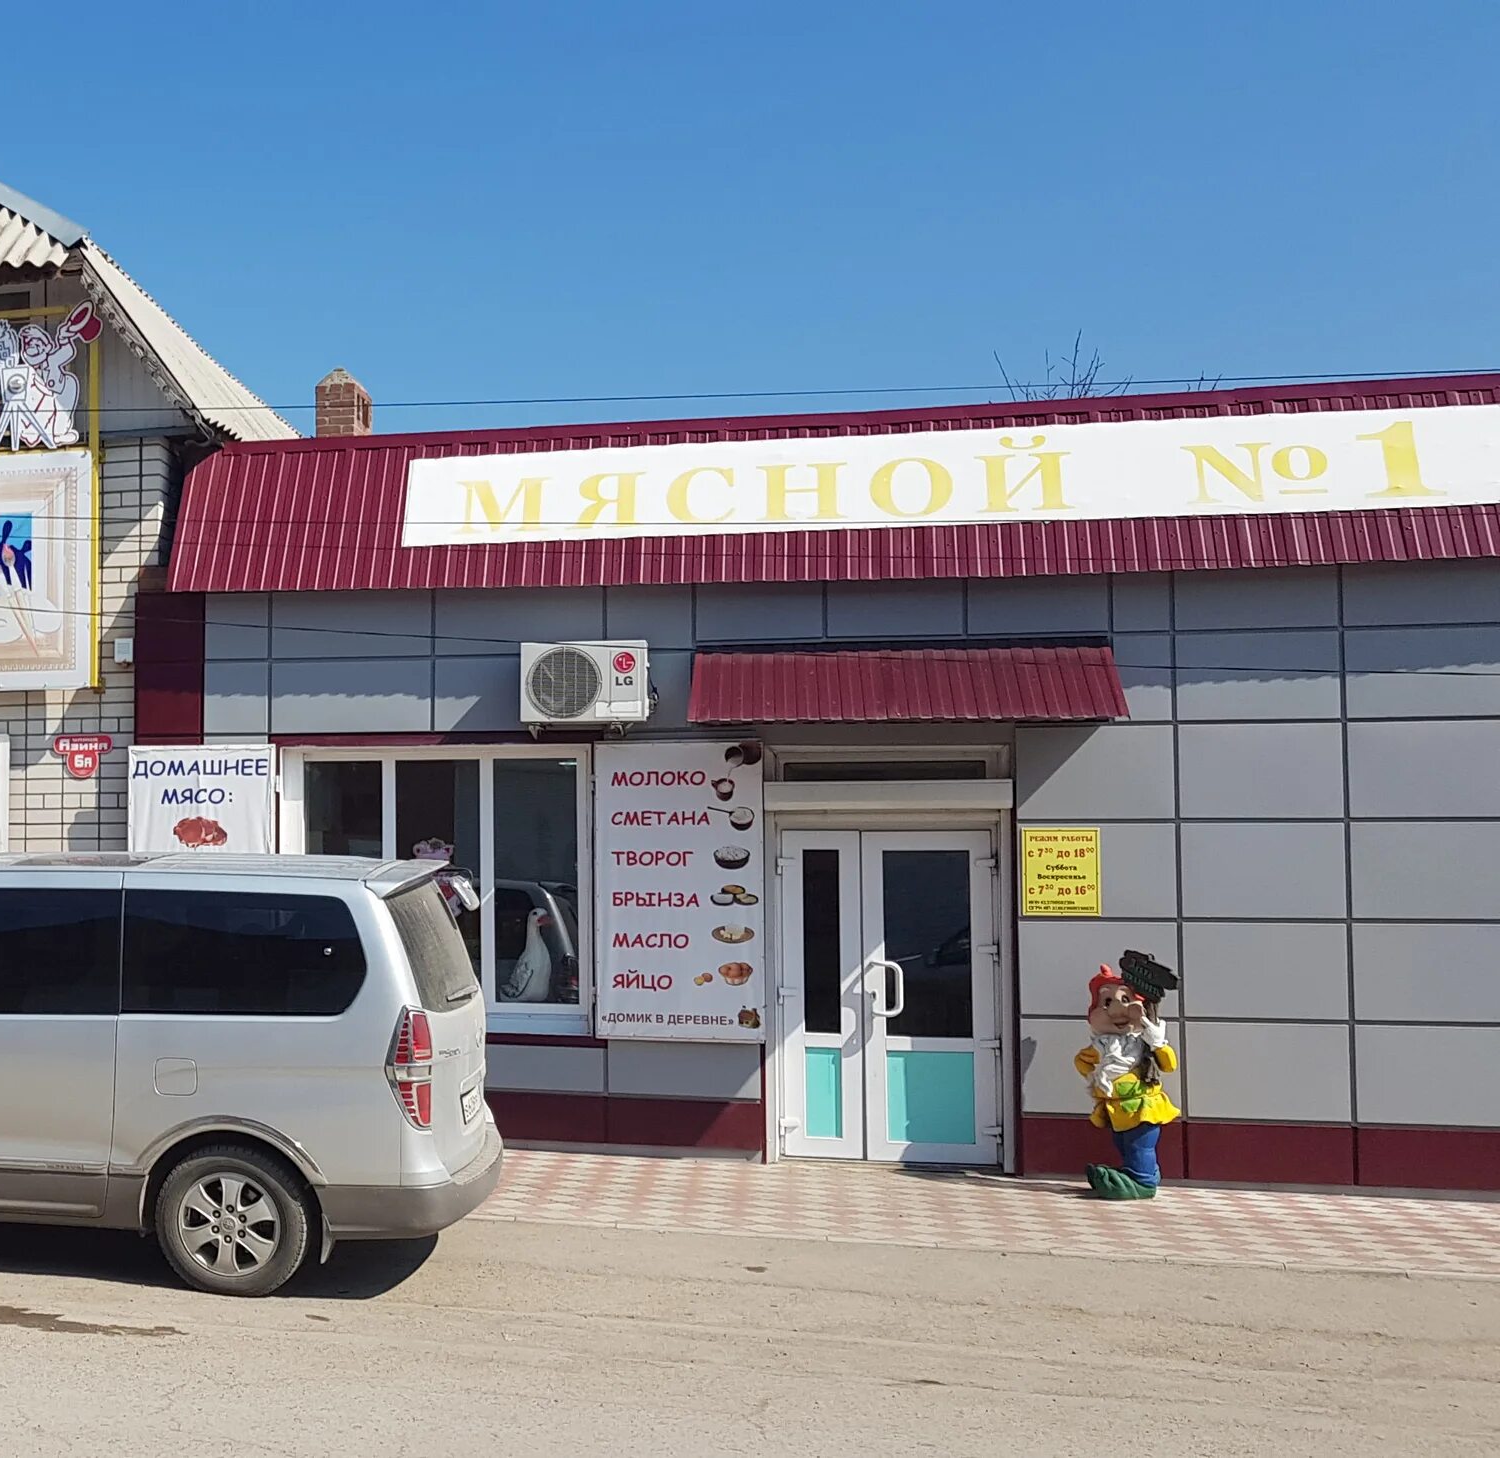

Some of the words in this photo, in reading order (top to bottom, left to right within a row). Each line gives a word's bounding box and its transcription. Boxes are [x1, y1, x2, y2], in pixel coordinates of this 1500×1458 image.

[456, 434, 1079, 534] МЯСНОЙ
[1356, 420, 1448, 498] 1
[615, 676, 633, 686] LG
[133, 759, 268, 779] ДОМАШНЕЕ
[611, 771, 706, 787] МОЛОКО
[611, 811, 710, 826] СМЕТАНА
[611, 851, 694, 866] ТВОРОГ
[1046, 864, 1077, 872] Суббота
[612, 892, 700, 907] БРЫНЗА
[612, 933, 690, 949] МАСЛО
[612, 969, 673, 991] ЯЙЦО
[655, 1014, 664, 1024] В
